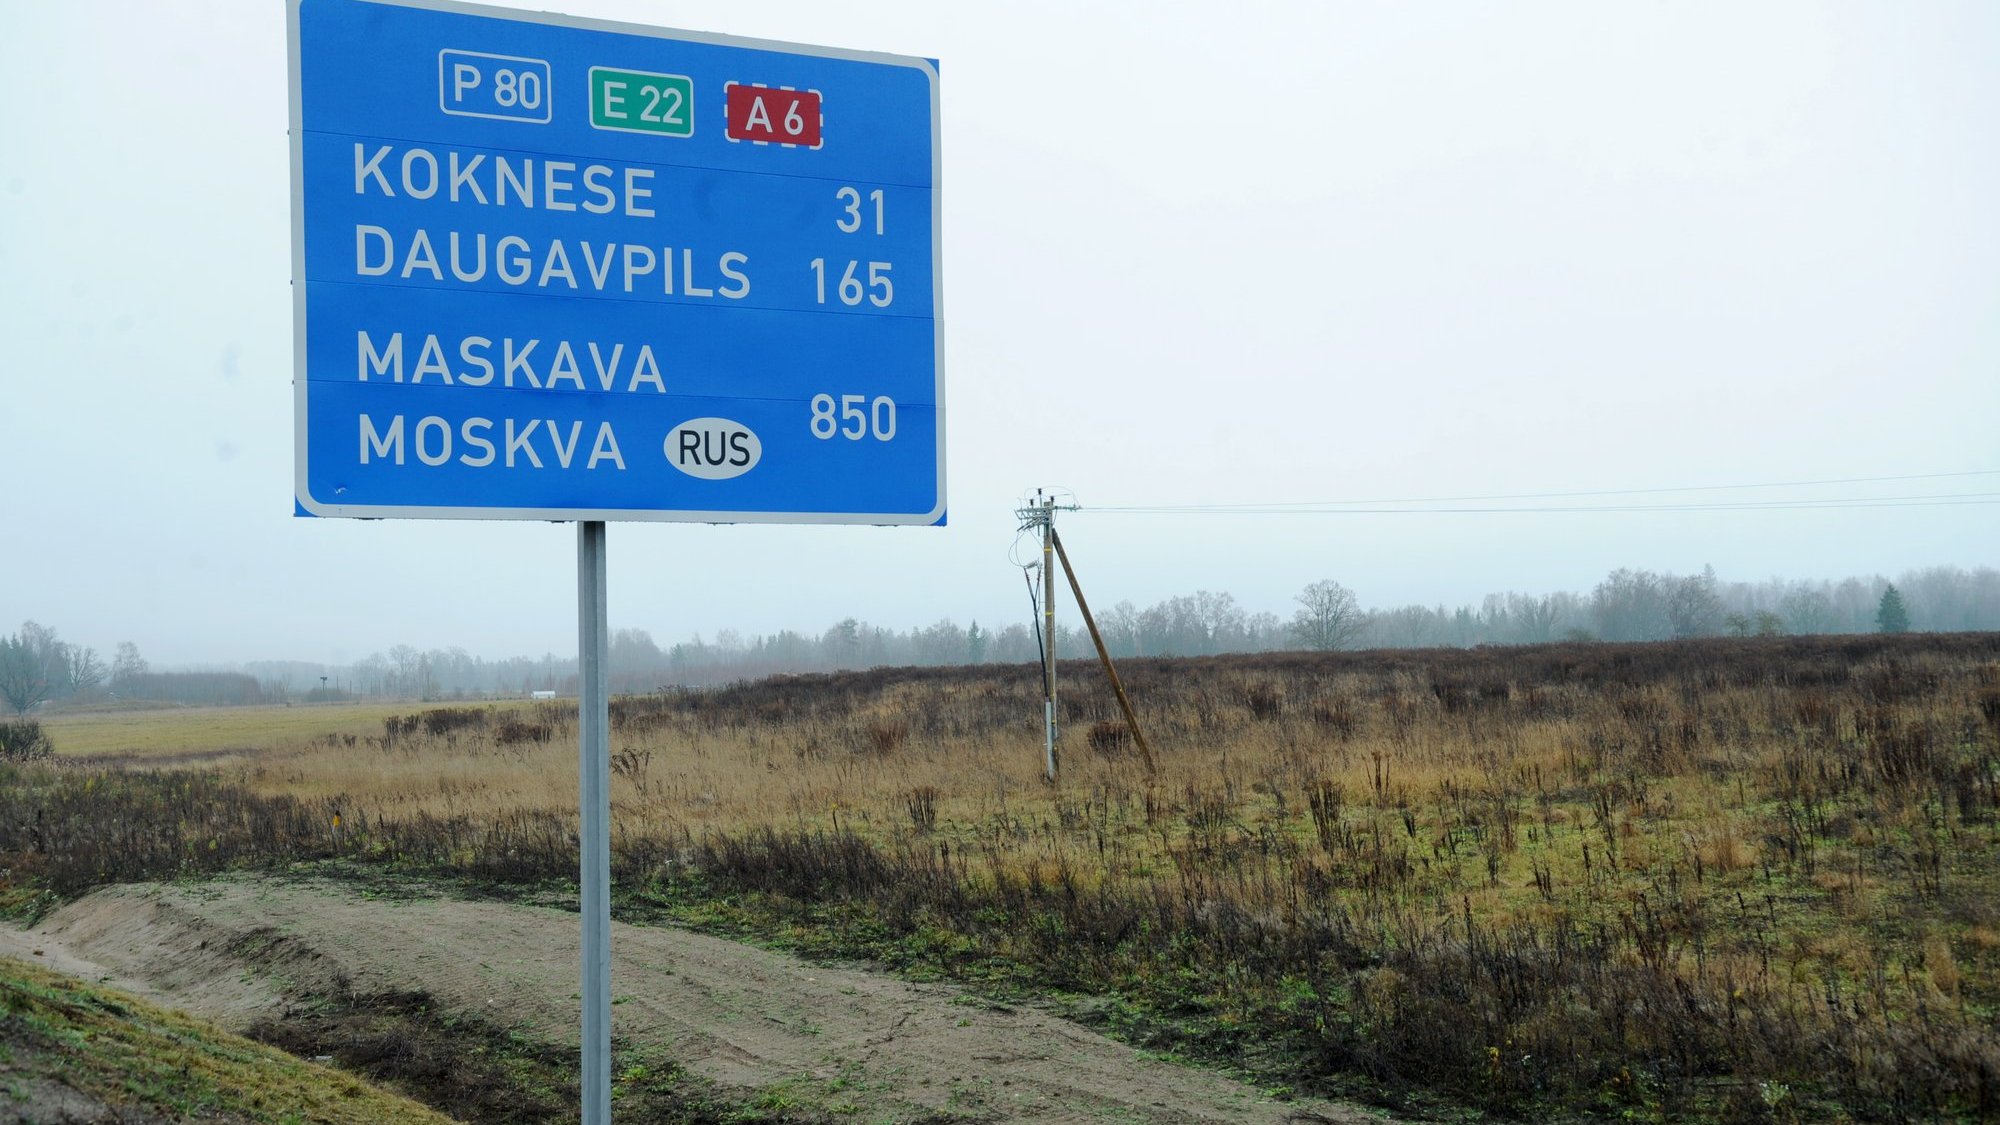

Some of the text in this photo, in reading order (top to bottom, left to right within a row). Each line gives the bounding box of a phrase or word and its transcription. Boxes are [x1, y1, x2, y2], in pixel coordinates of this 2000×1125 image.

[453, 64, 542, 110] P 80
[603, 81, 684, 125] E 22
[745, 97, 805, 135] A 6
[354, 143, 656, 218] KOKNESE
[836, 186, 886, 234] 31
[356, 225, 751, 299] DAUGAVPILS
[811, 258, 894, 308] 165
[357, 330, 667, 393] MASKAVA
[810, 393, 897, 441] 850
[359, 413, 627, 470] MOSKVA
[679, 429, 752, 466] RUS
